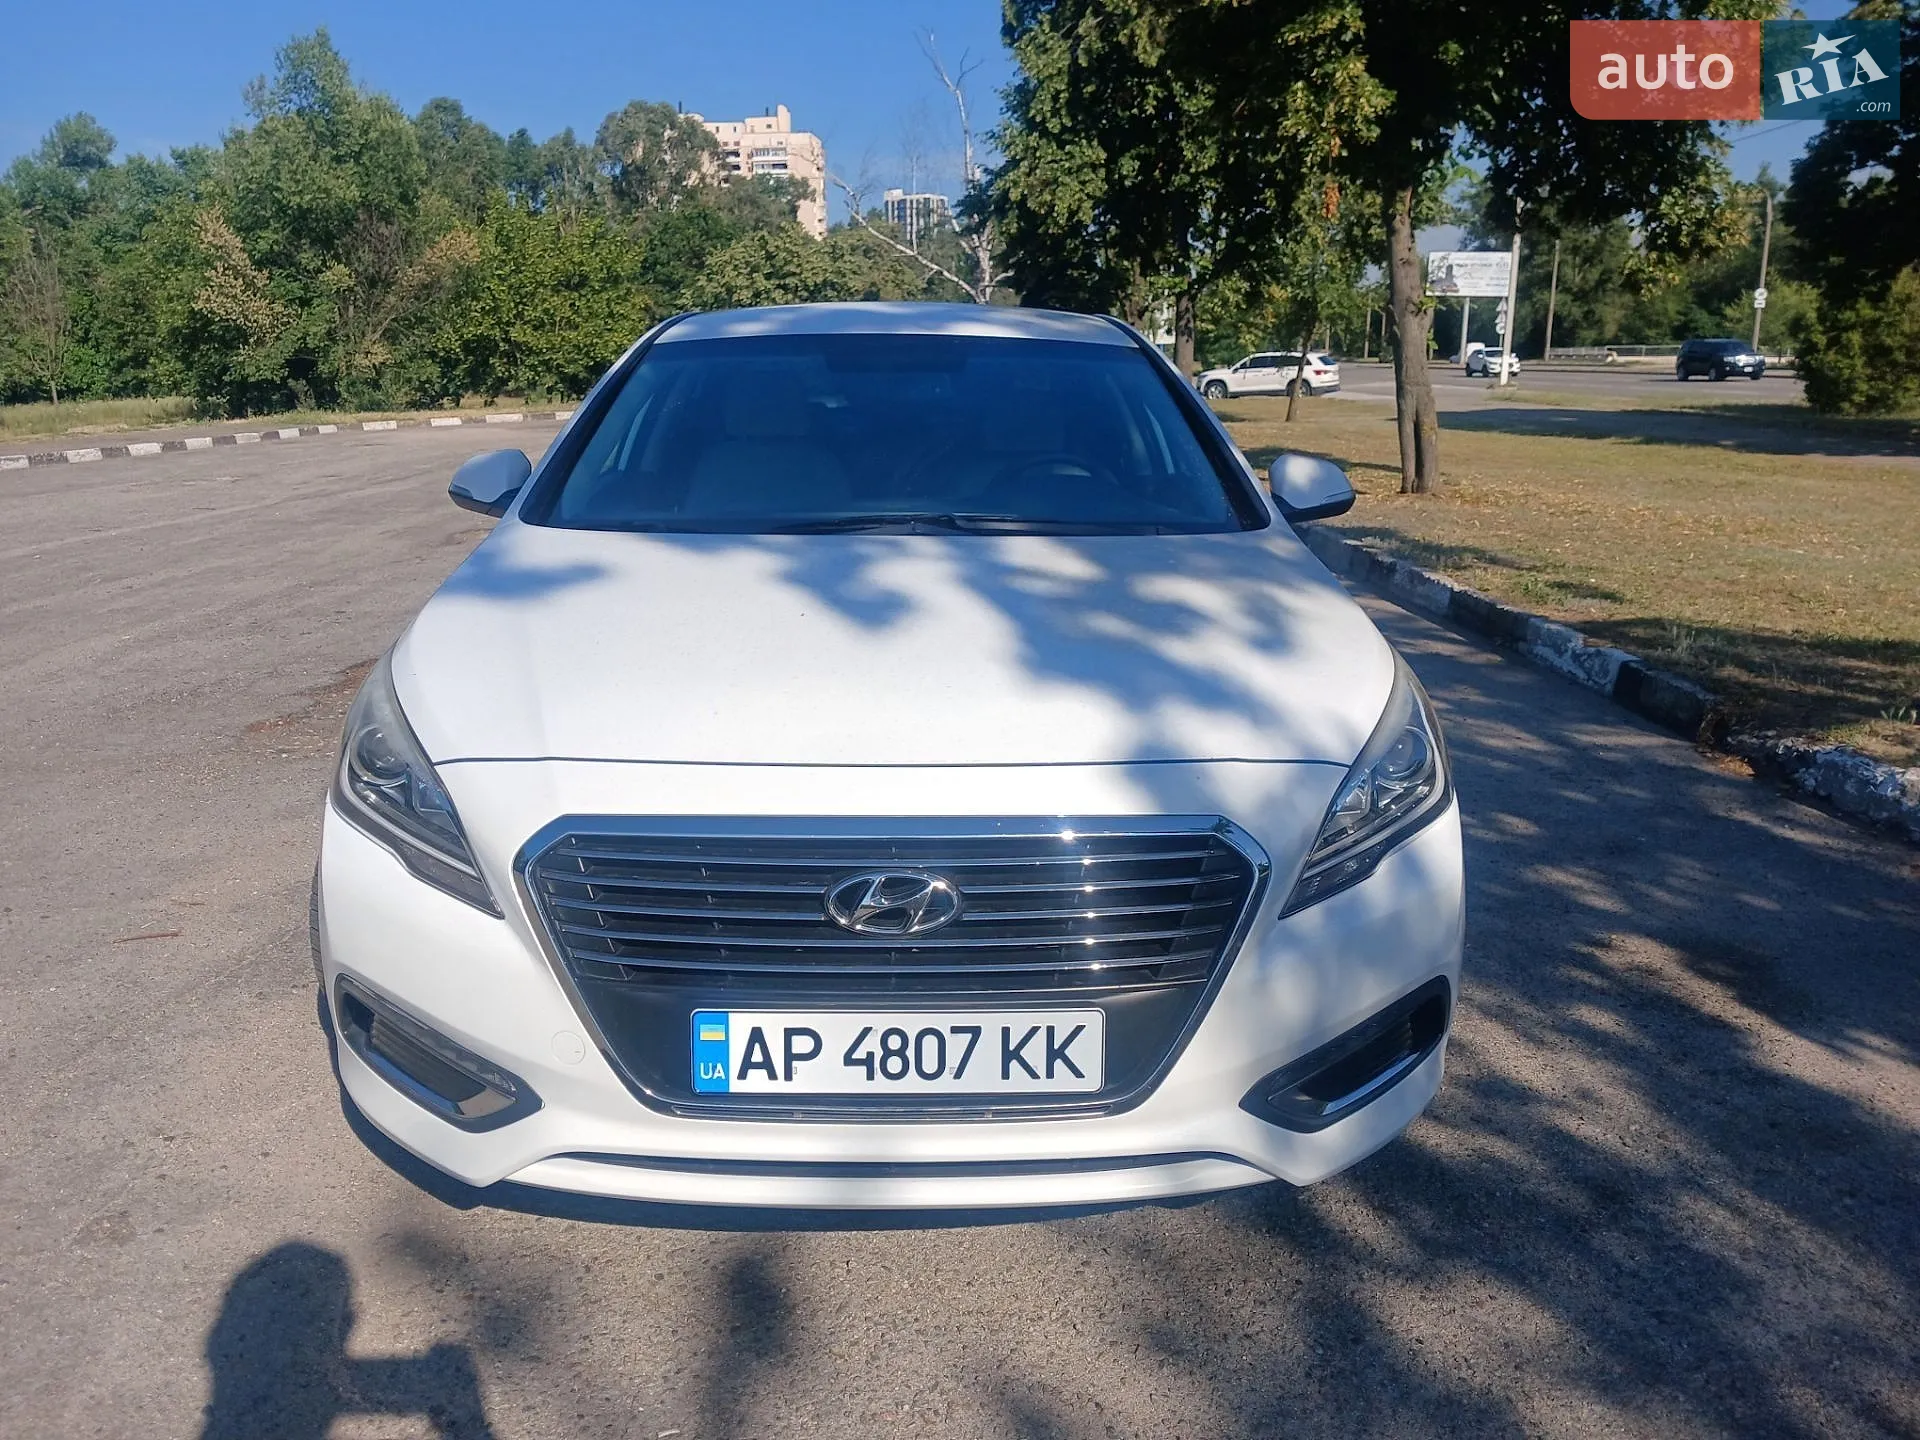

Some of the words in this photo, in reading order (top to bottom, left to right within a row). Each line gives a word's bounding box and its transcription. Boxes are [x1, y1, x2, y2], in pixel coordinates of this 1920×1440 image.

[700, 1063, 726, 1080] UA
[736, 1026, 823, 1082] AP
[842, 1025, 982, 1082] 4807
[1000, 1024, 1087, 1081] KK
